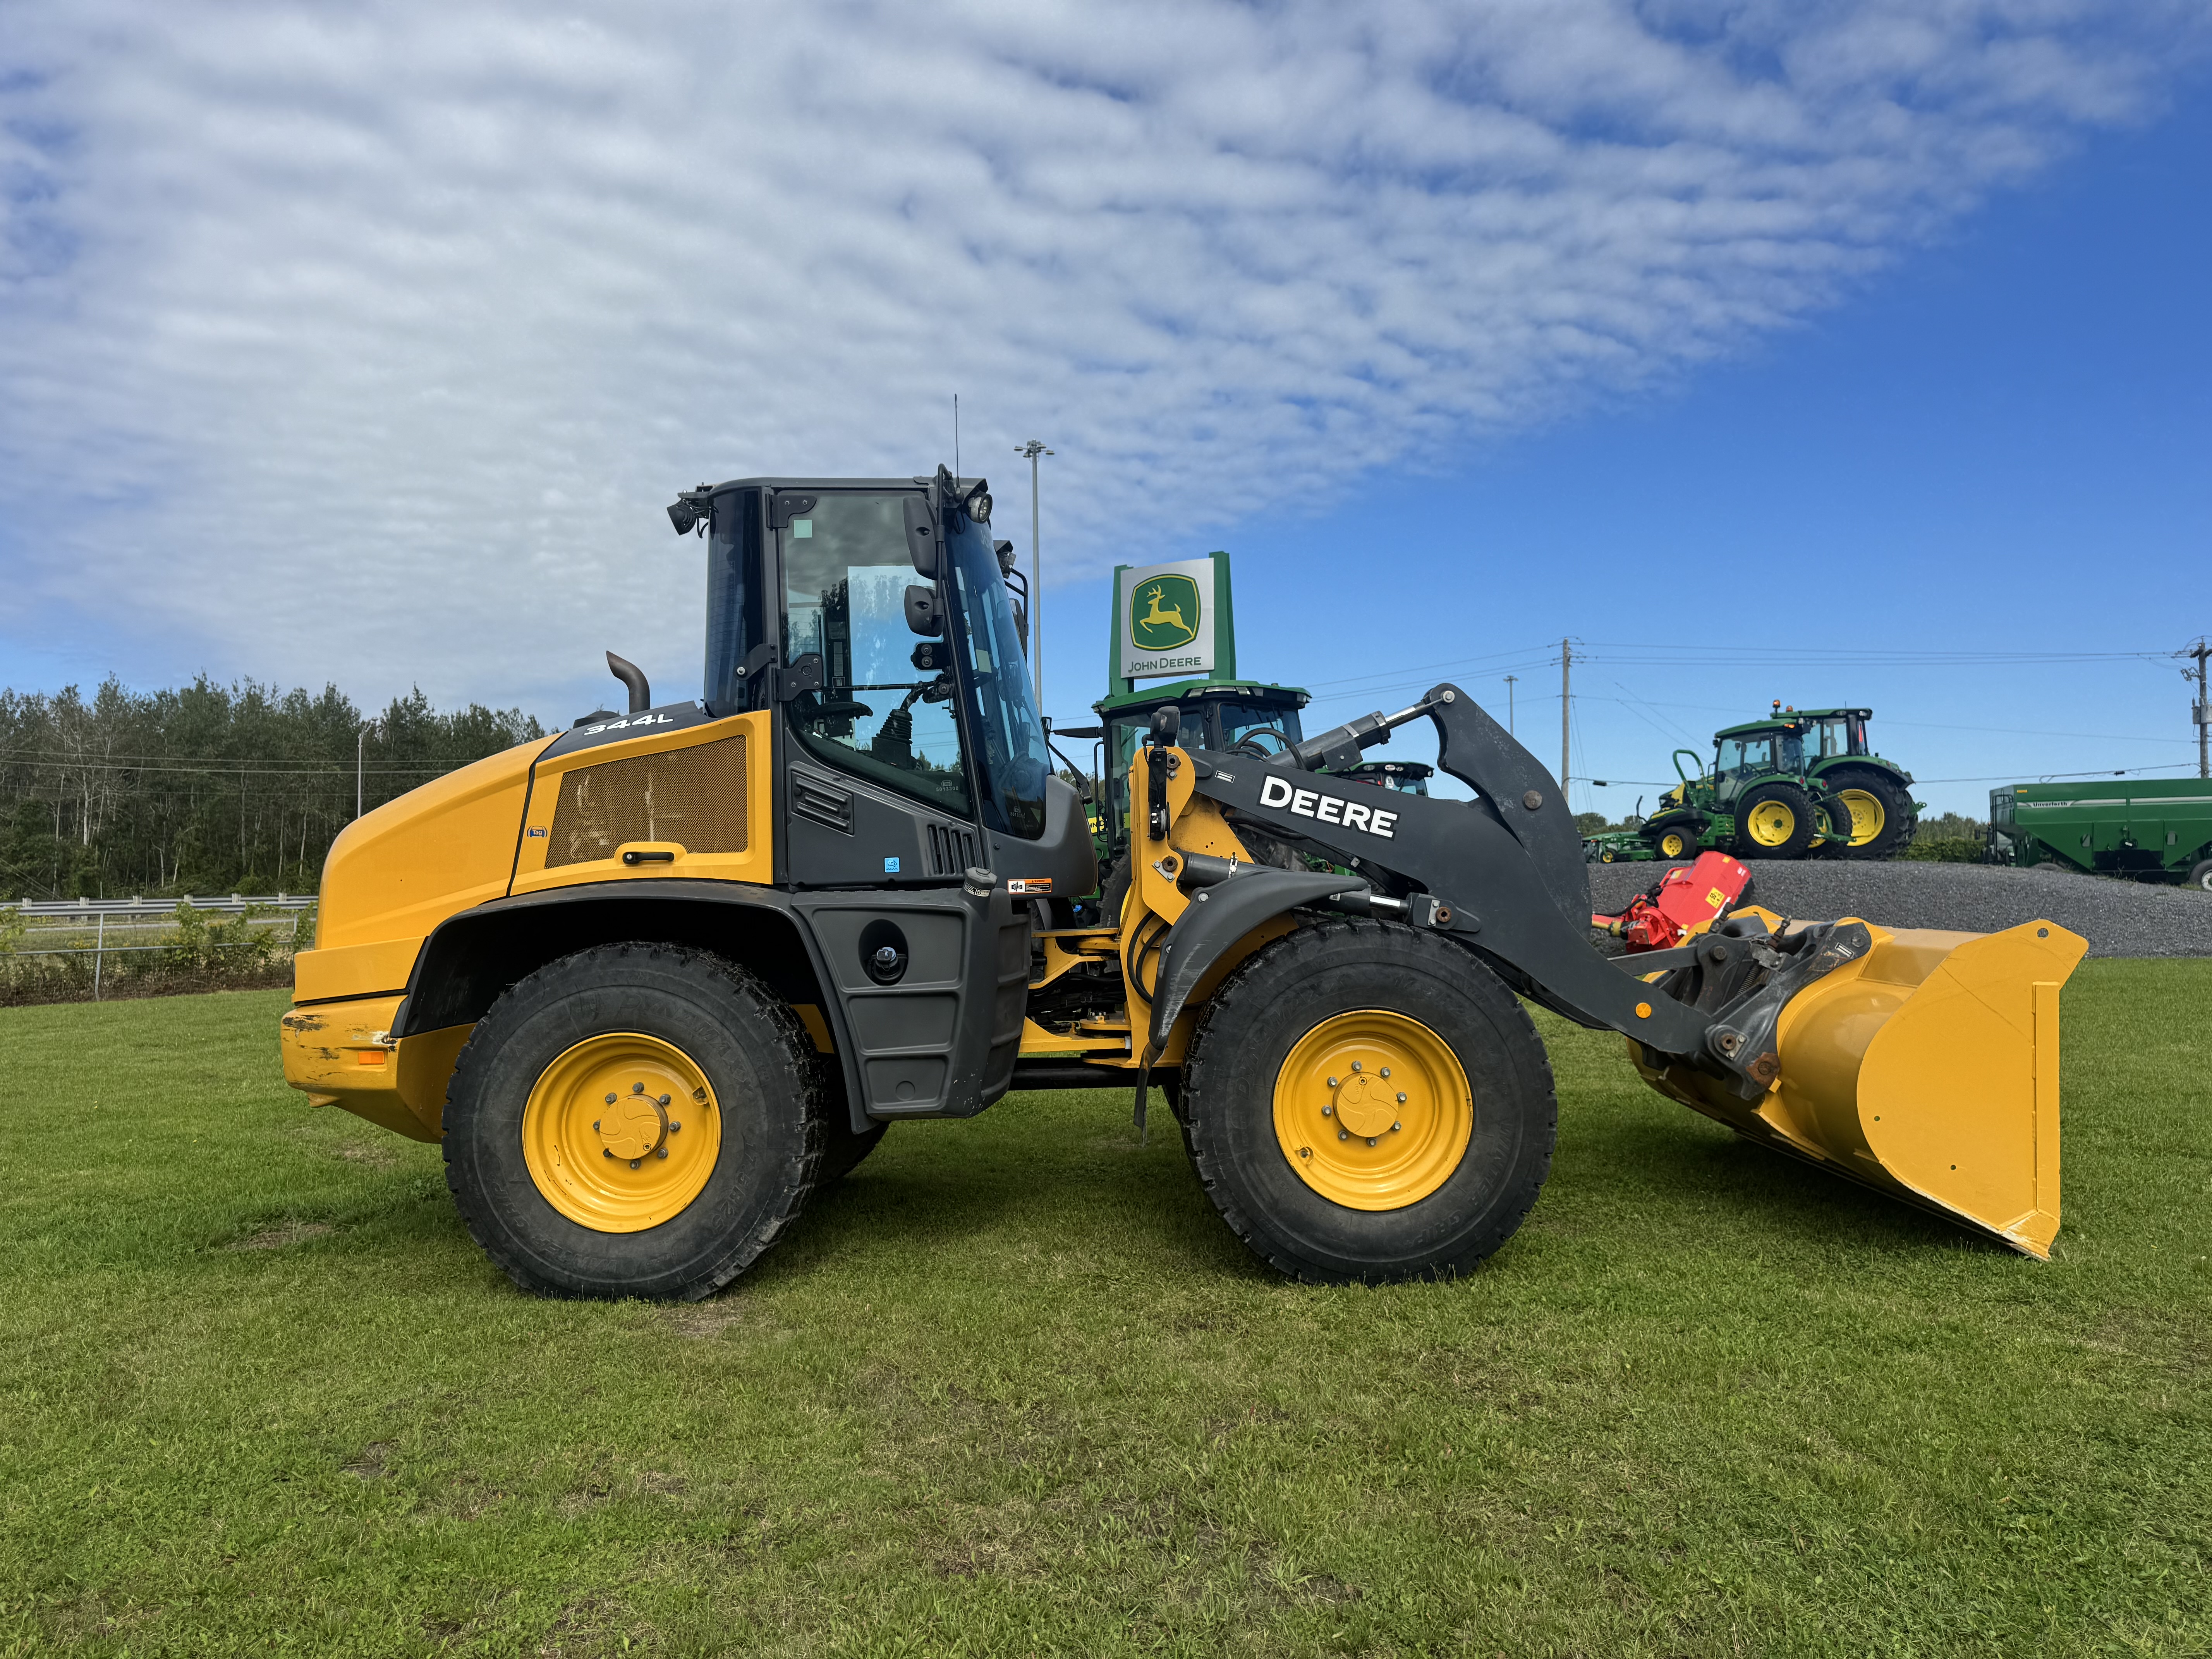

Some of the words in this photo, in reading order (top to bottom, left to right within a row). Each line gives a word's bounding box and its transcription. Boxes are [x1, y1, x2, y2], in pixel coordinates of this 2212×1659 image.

[1128, 660, 1158, 673] JOHN
[1159, 656, 1201, 669] DEERE
[584, 714, 673, 735] 344L
[1259, 775, 1398, 838] DEERE
[620, 992, 754, 1097] DYNAMAXX
